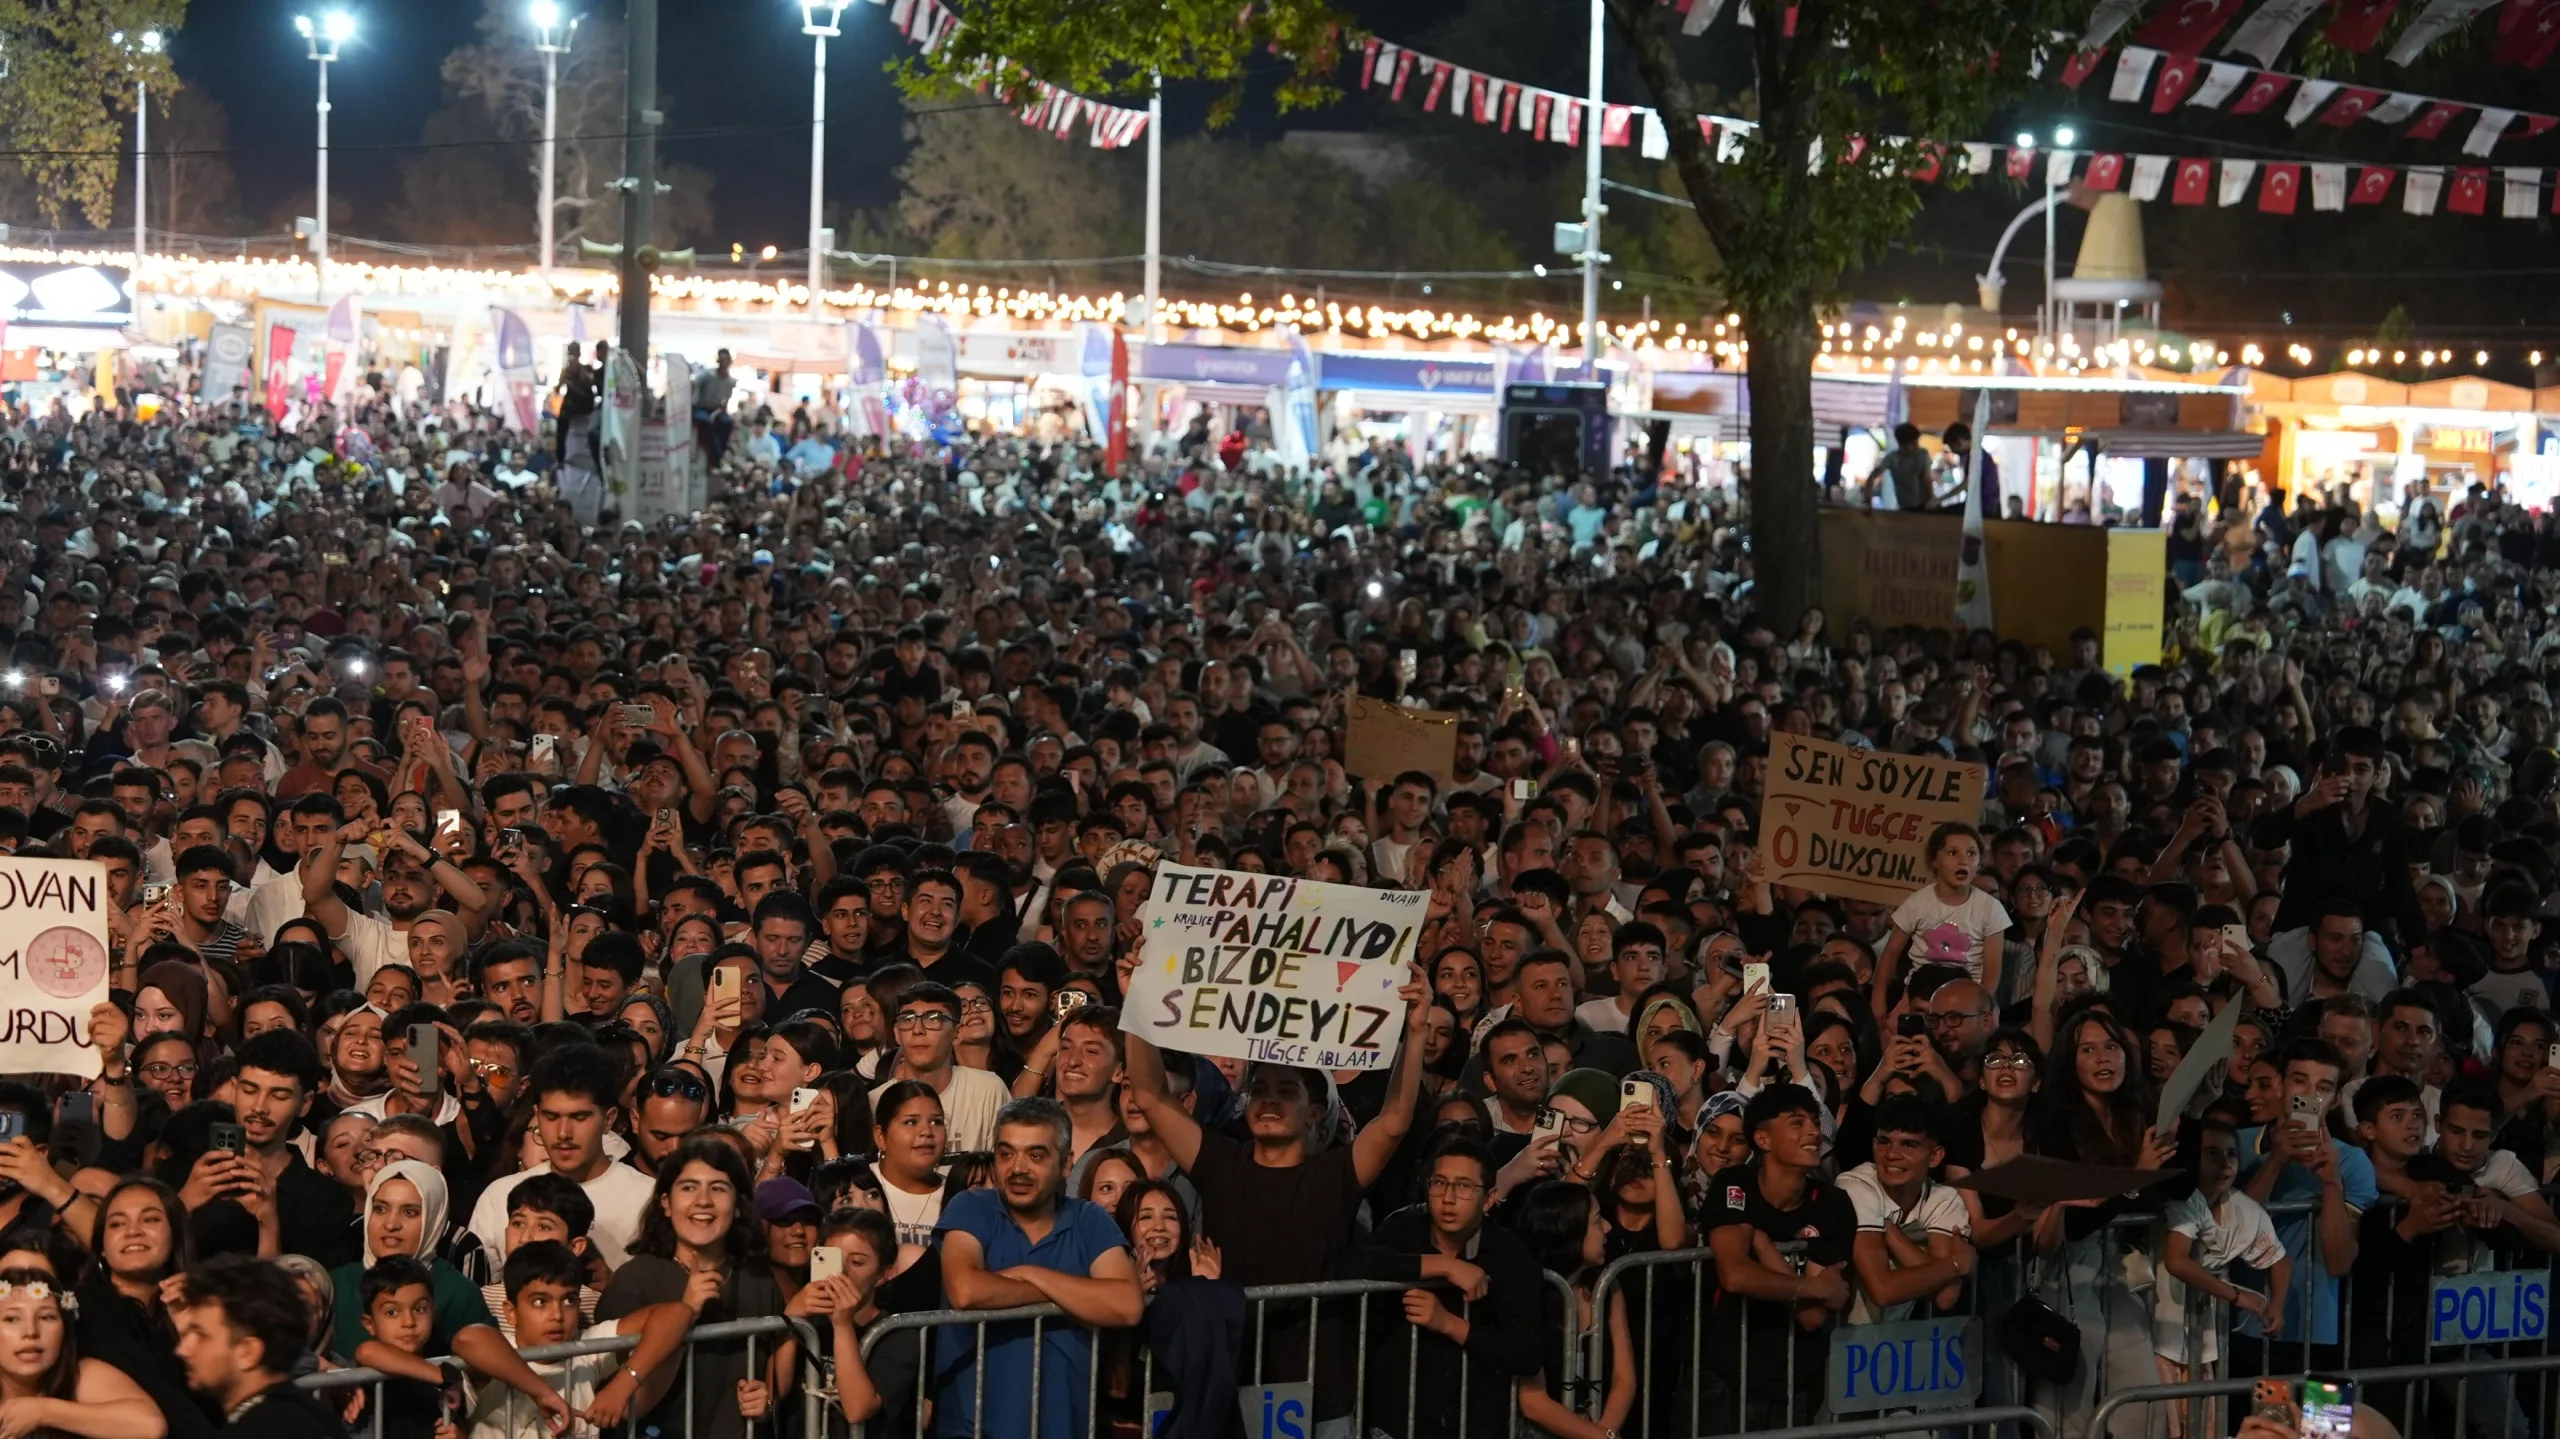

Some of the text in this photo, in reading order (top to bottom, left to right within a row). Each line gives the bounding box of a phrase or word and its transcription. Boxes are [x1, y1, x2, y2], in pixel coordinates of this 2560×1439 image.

[1785, 744, 1962, 803] SEN SÖYLE
[1829, 799, 1924, 844] TUĞÇE,
[1772, 825, 1929, 885] O DUYSUN...
[1162, 872, 1298, 911] TERAPİ
[1209, 909, 1412, 966] PAHALIYDI
[1182, 945, 1308, 989] BİZDE
[1153, 987, 1391, 1049] SENDEYİZ
[1247, 1038, 1381, 1068] TUĞÇE ABLAA!
[2433, 1275, 2545, 1342] POLİS
[1845, 1325, 1965, 1399] POLİS
